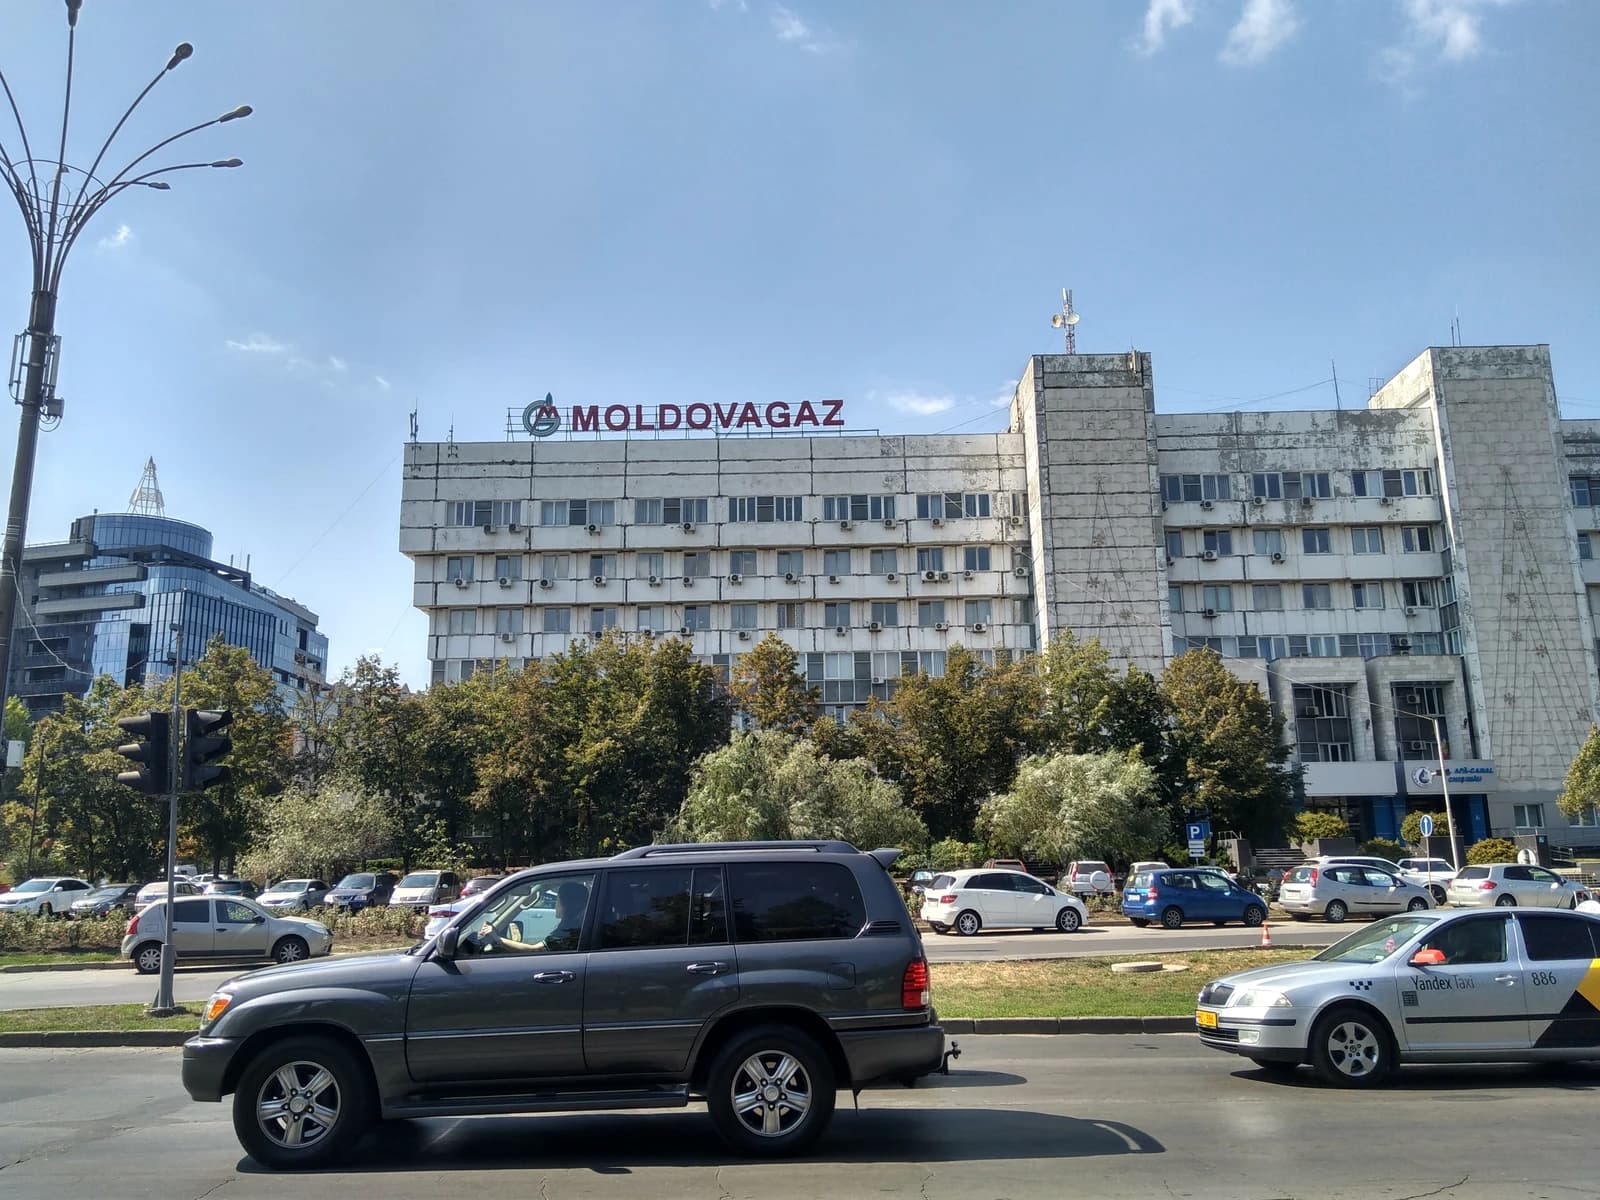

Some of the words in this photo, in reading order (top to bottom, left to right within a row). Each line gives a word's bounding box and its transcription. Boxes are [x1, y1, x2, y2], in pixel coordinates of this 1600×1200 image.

[572, 399, 845, 432] MOLDOVAGAZ
[1190, 825, 1200, 839] P
[1410, 975, 1452, 991] Yandex
[1453, 975, 1475, 990] Taxi
[1531, 971, 1557, 987] 886
